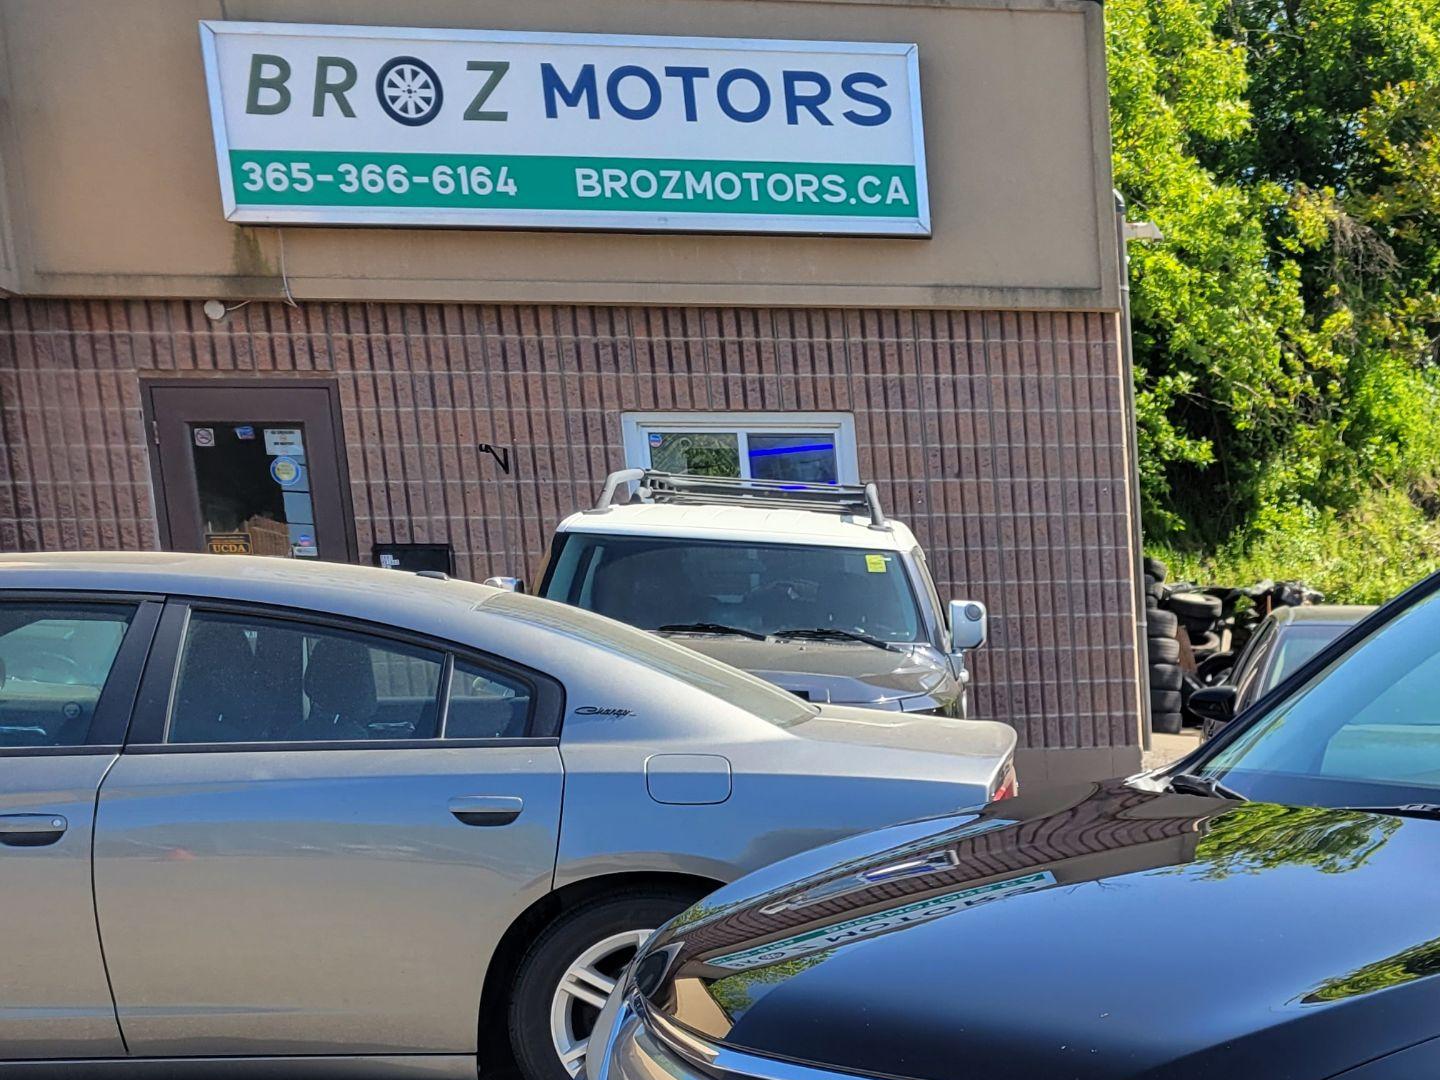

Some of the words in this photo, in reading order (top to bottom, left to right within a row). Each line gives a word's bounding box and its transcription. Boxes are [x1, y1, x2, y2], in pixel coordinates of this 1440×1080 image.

[245, 53, 511, 128] BROZ
[540, 62, 893, 127] MOTORS
[241, 160, 518, 197] 365-366-6164
[575, 167, 911, 206] BROZMOTORS.CA
[212, 544, 247, 553] UCDA
